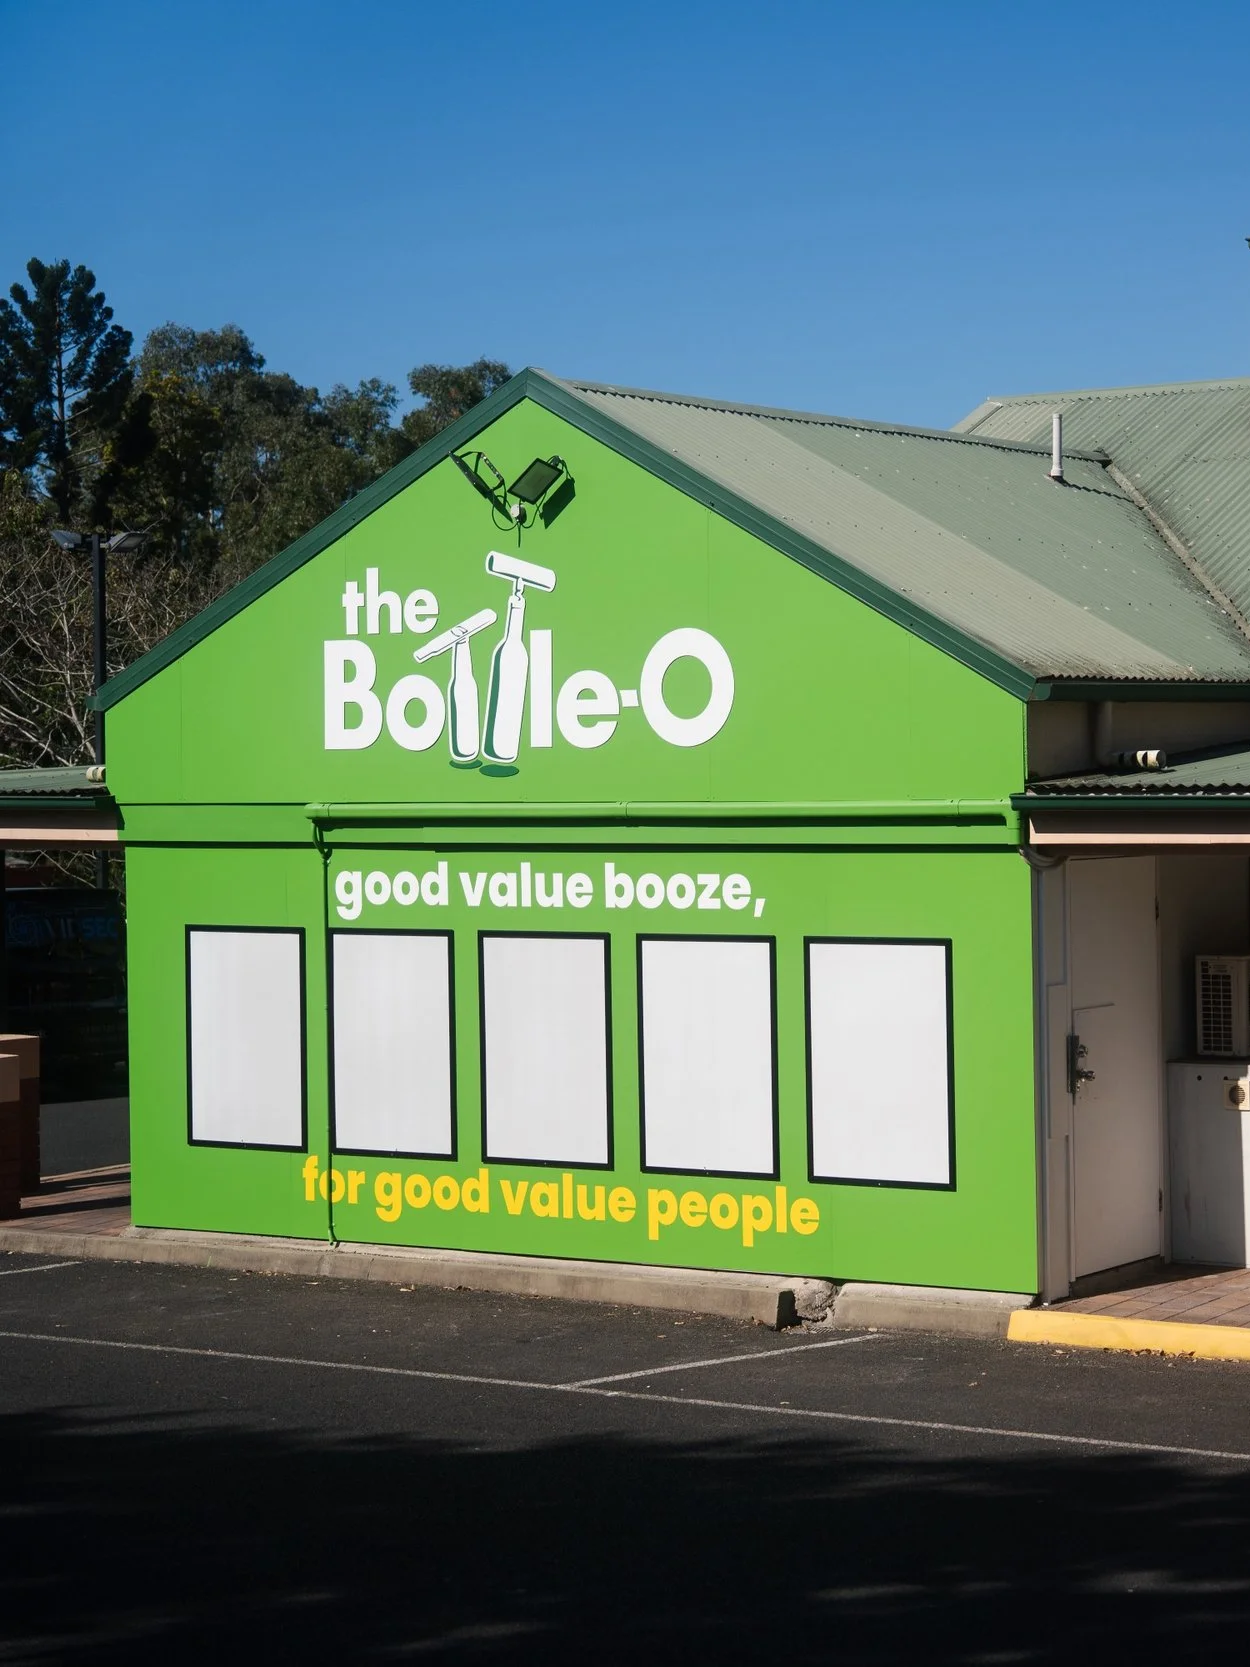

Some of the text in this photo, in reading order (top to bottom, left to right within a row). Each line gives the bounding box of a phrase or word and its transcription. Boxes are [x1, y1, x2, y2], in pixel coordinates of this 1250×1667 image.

[342, 568, 438, 635] the
[324, 551, 735, 764] Bottle-O
[335, 861, 766, 921] good value booze,
[303, 1155, 820, 1248] for good value people
